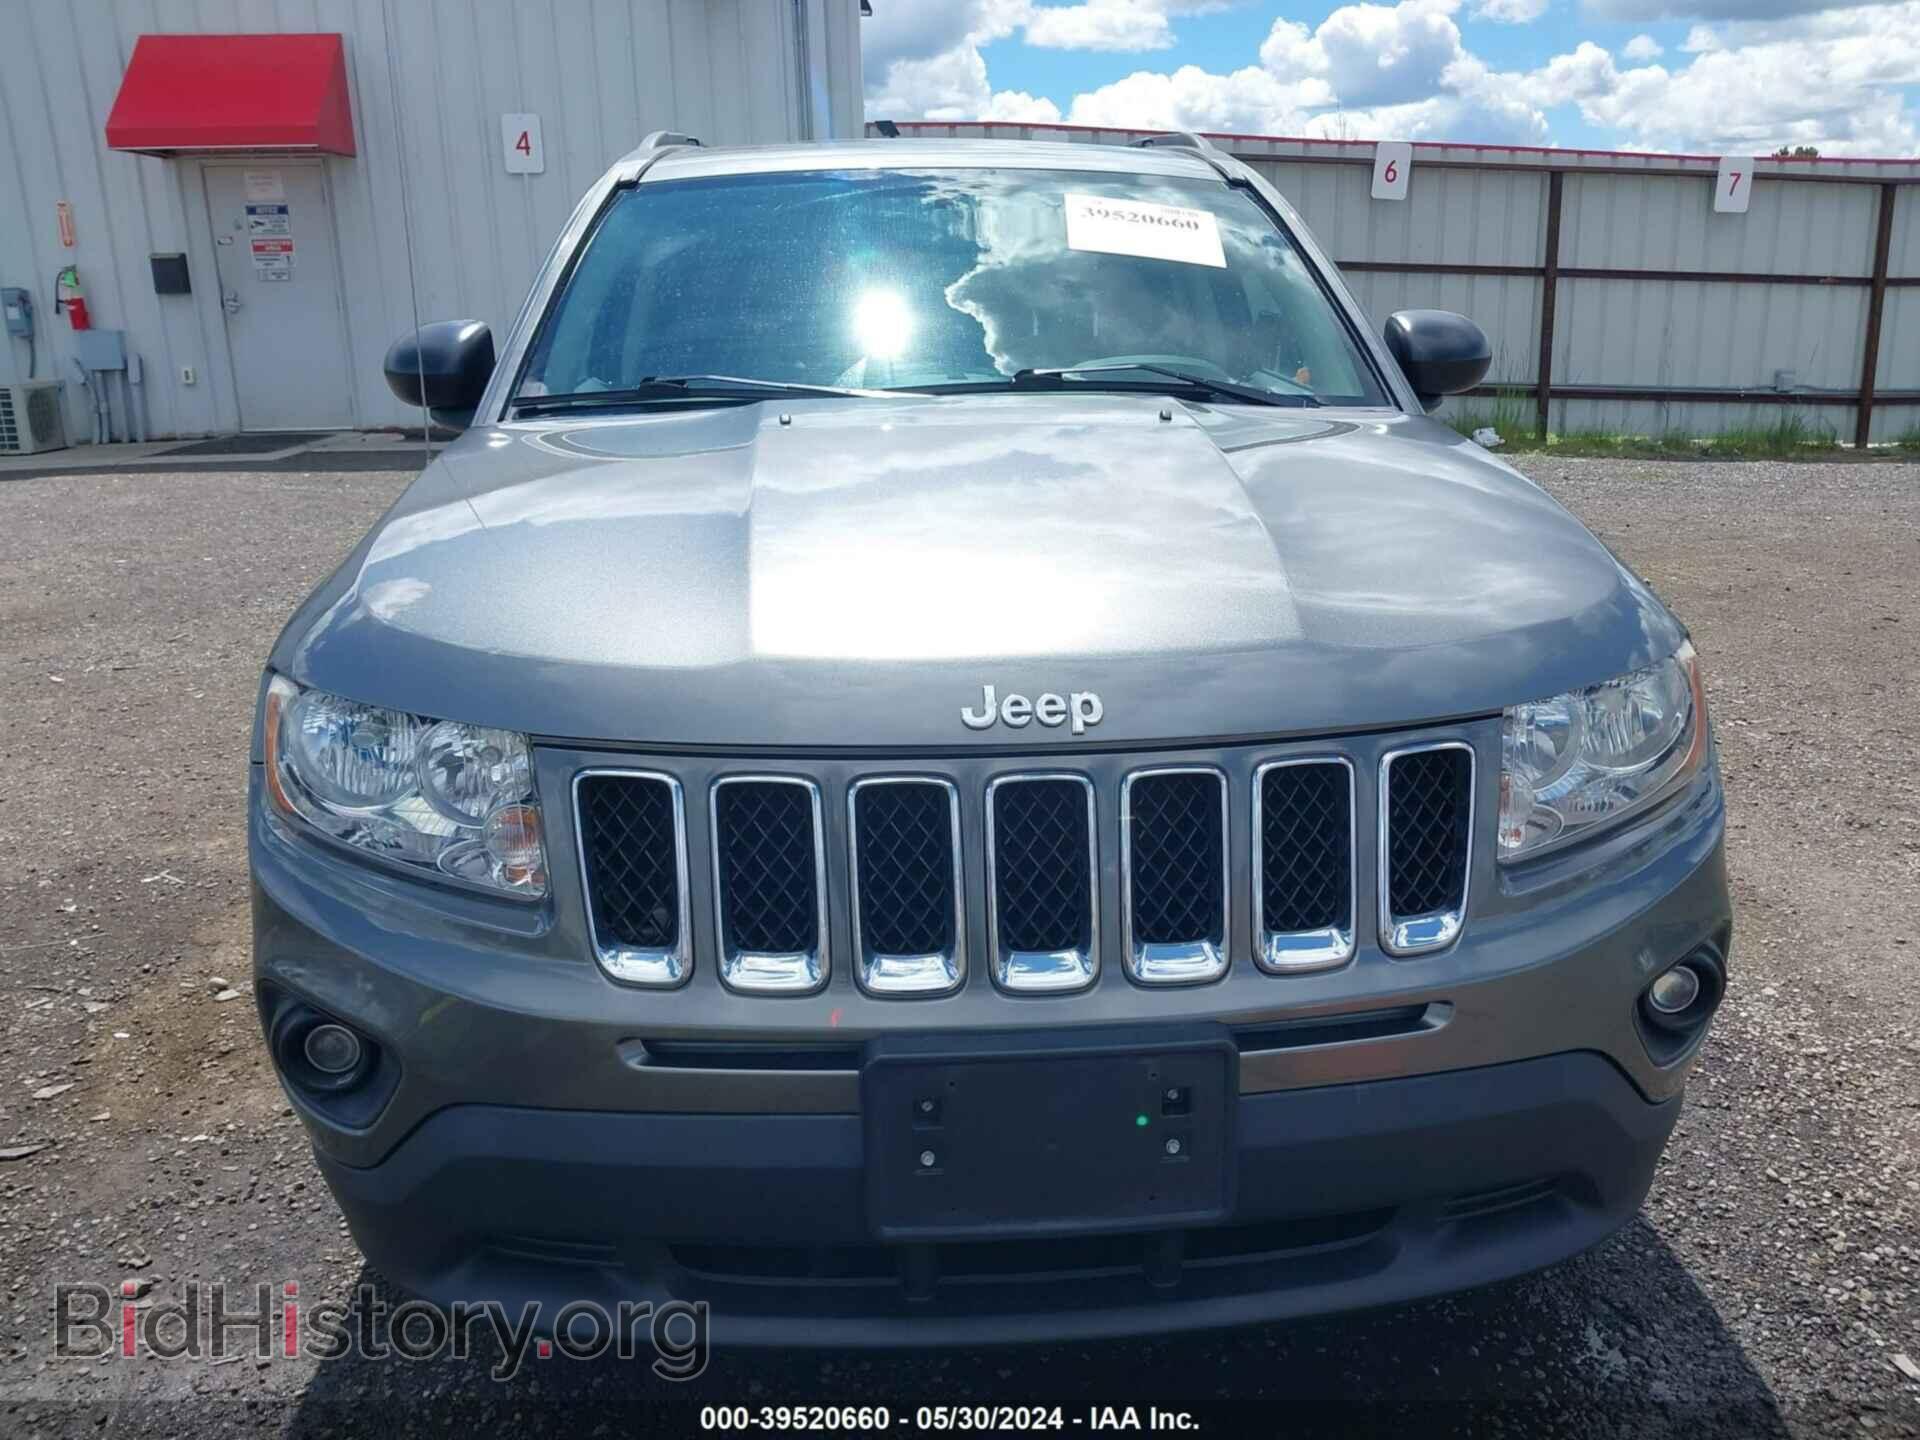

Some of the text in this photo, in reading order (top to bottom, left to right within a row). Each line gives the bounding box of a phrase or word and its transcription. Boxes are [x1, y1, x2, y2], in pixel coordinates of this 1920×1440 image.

[516, 130, 531, 156] 4
[1384, 159, 1397, 183] 6
[1729, 172, 1742, 197] 7
[961, 685, 1104, 735] Jeep
